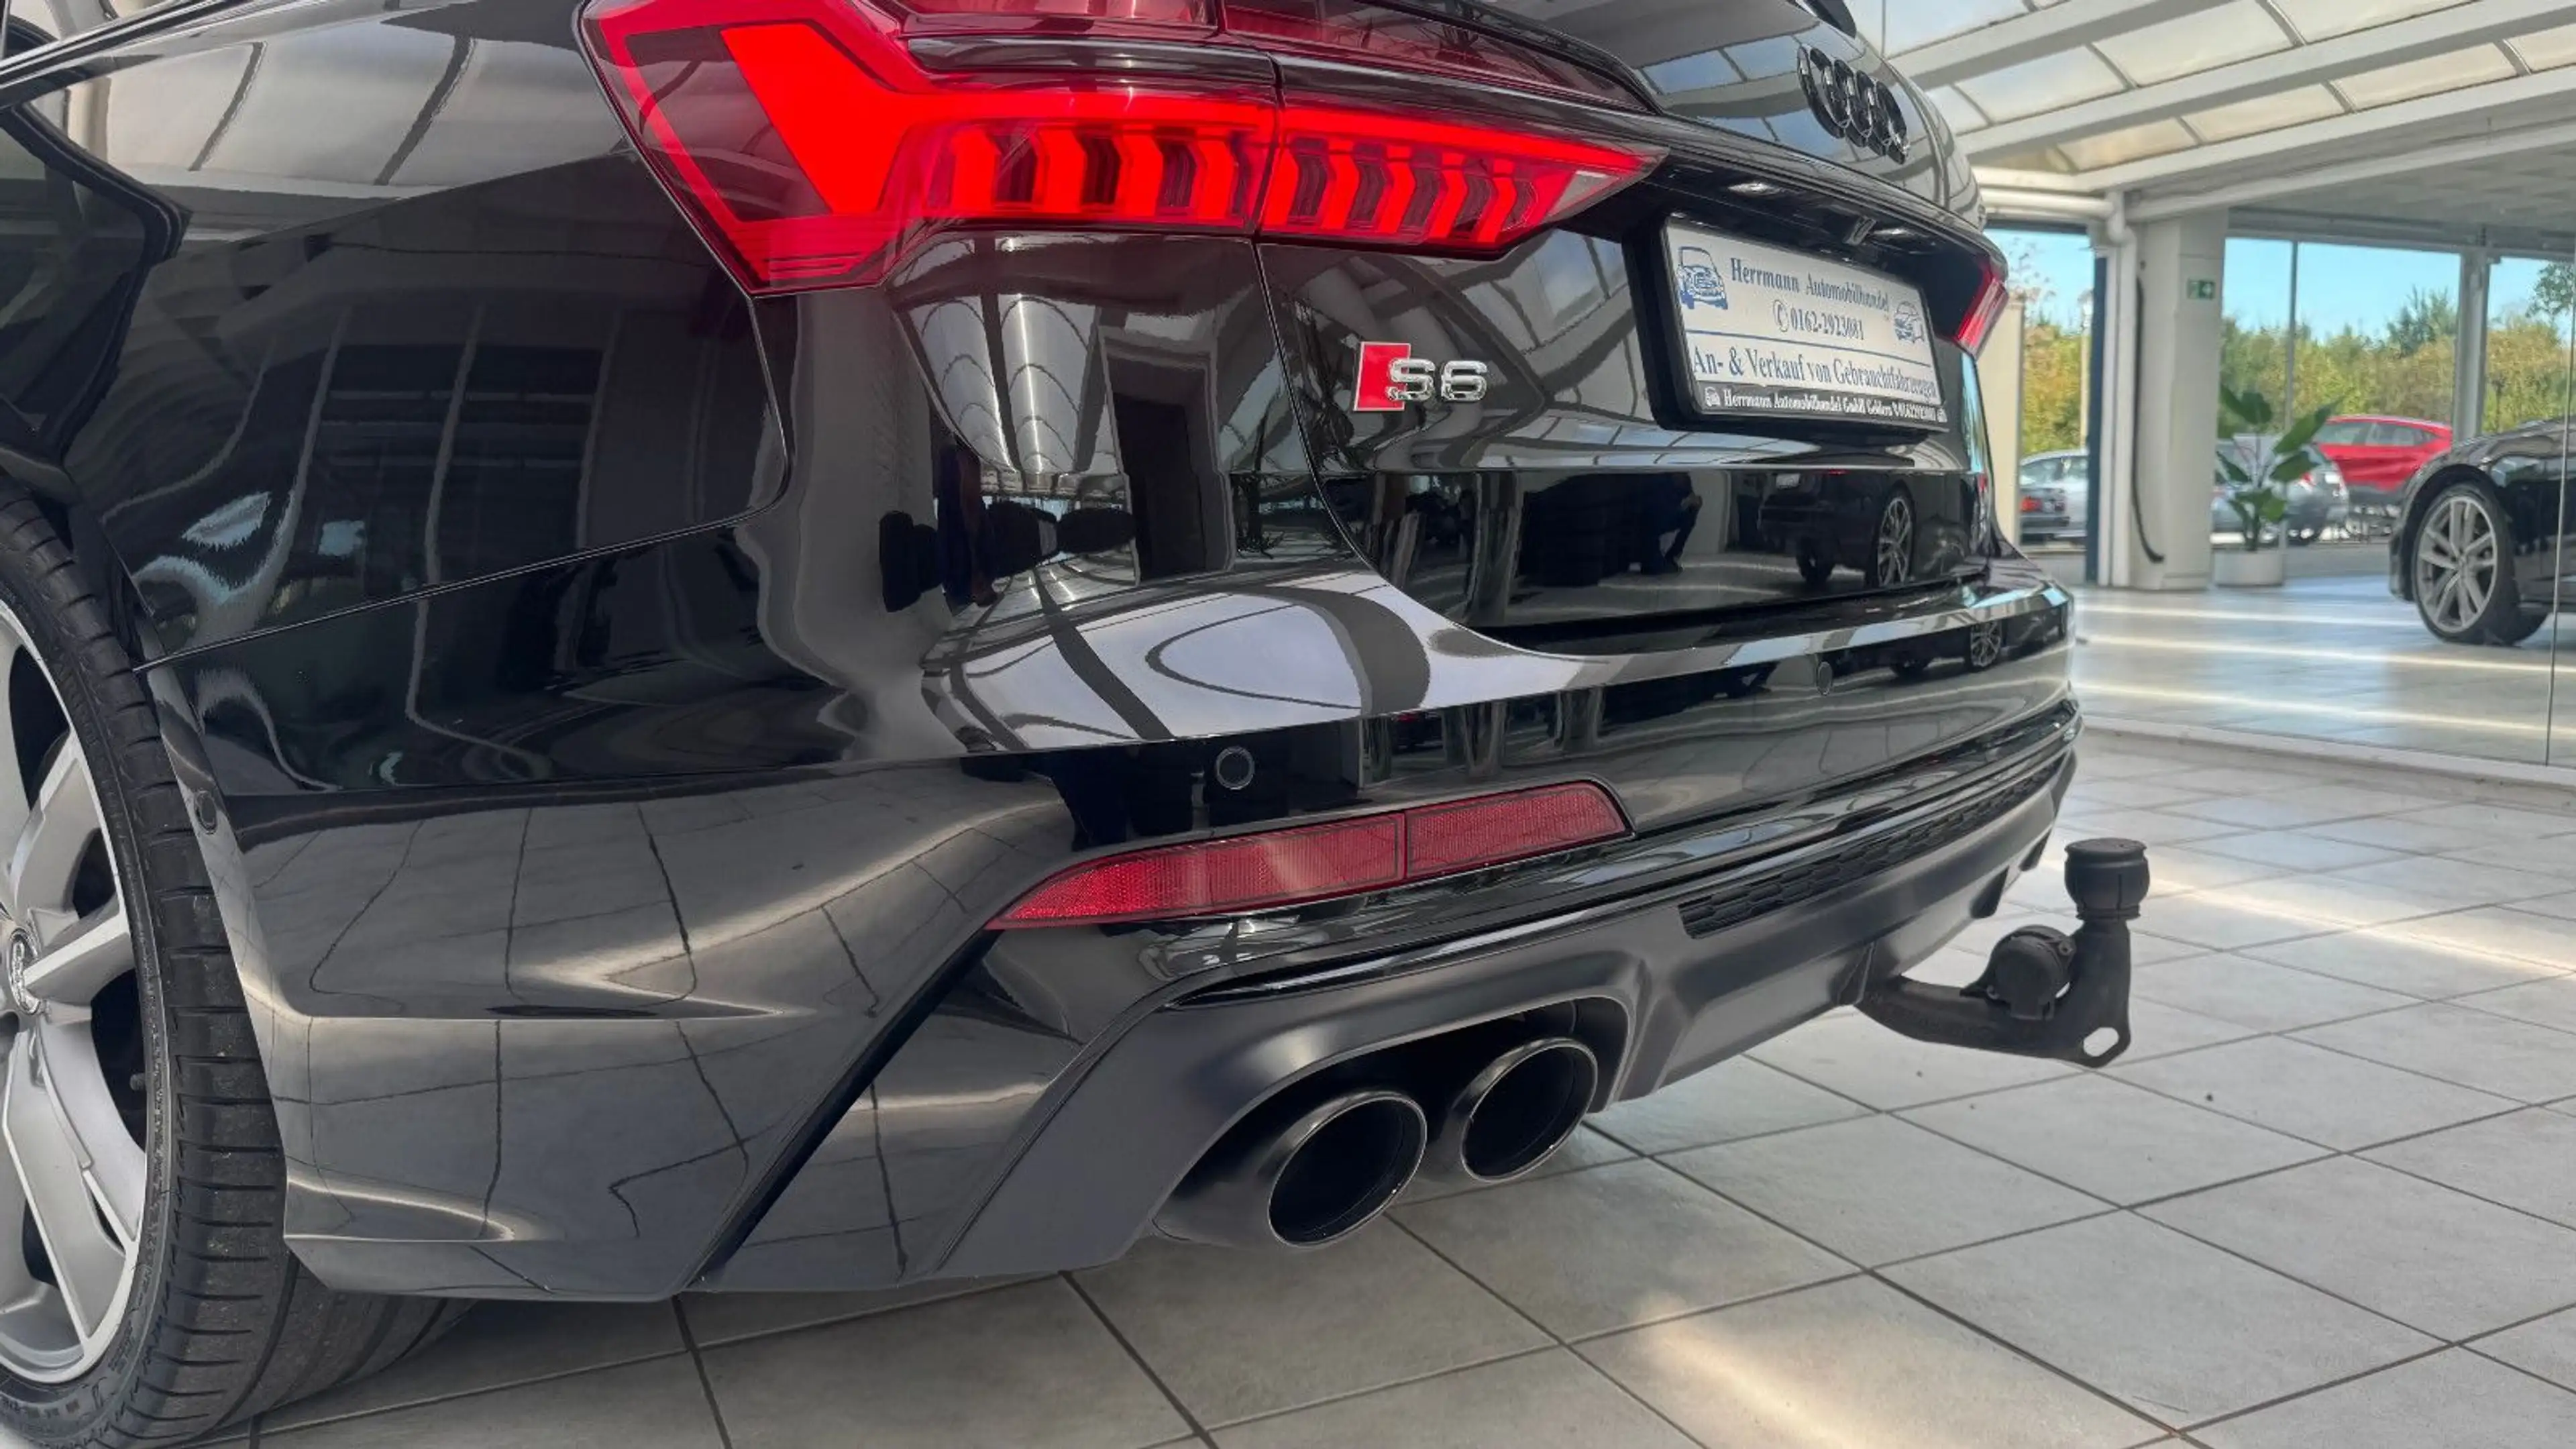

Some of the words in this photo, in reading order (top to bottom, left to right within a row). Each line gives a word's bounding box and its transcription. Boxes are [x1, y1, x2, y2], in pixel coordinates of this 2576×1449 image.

[1731, 258, 1800, 294] Herrmann
[1806, 272, 1890, 312] Automobilhandel
[1385, 358, 1489, 402] S6
[1693, 345, 1724, 374] An-
[1729, 346, 1744, 376] &
[1745, 347, 1806, 381] Verkauf
[1807, 362, 1832, 384] von
[1723, 388, 1772, 409] Herrmann
